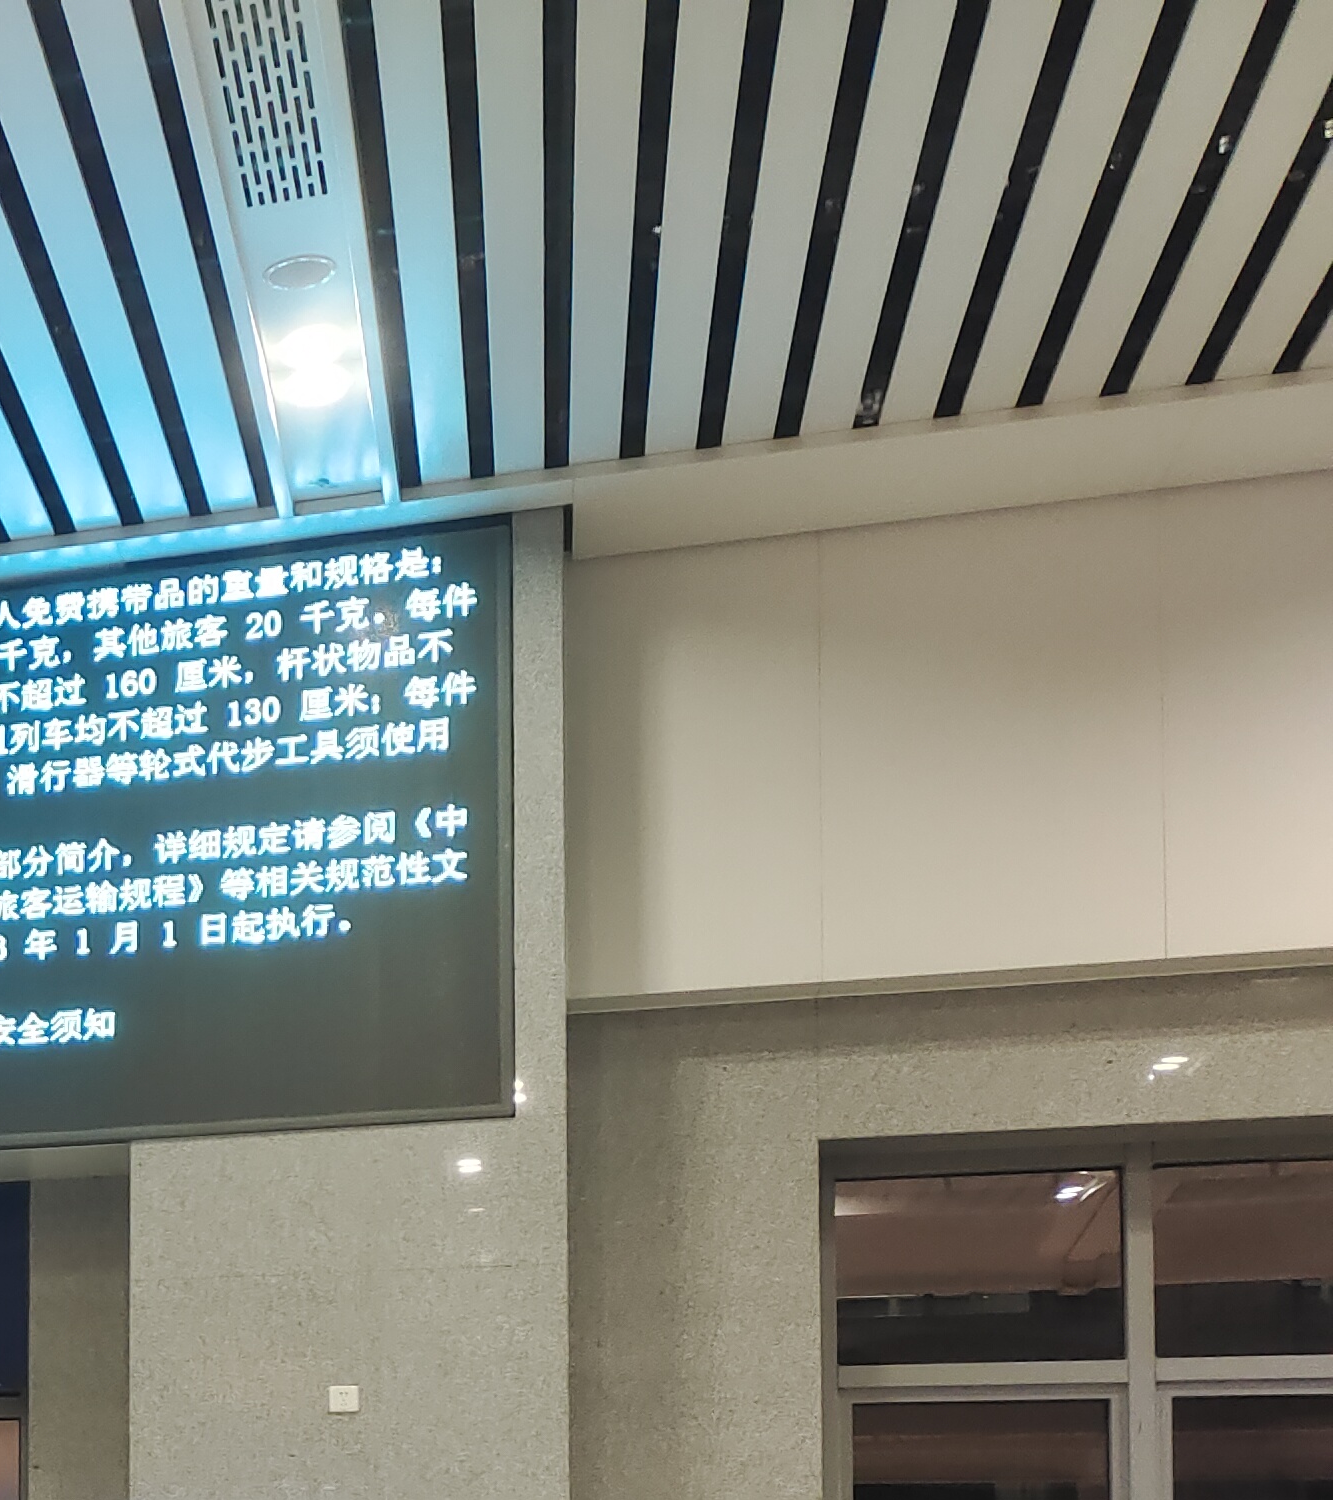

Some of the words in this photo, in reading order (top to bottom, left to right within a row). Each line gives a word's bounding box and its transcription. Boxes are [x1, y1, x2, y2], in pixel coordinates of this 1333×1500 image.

[245, 610, 281, 640] 20
[106, 668, 156, 699] 160
[228, 696, 280, 728] 130
[24, 928, 57, 960] 年
[77, 928, 90, 955] 1
[109, 920, 137, 954] 月
[163, 921, 177, 948] 1
